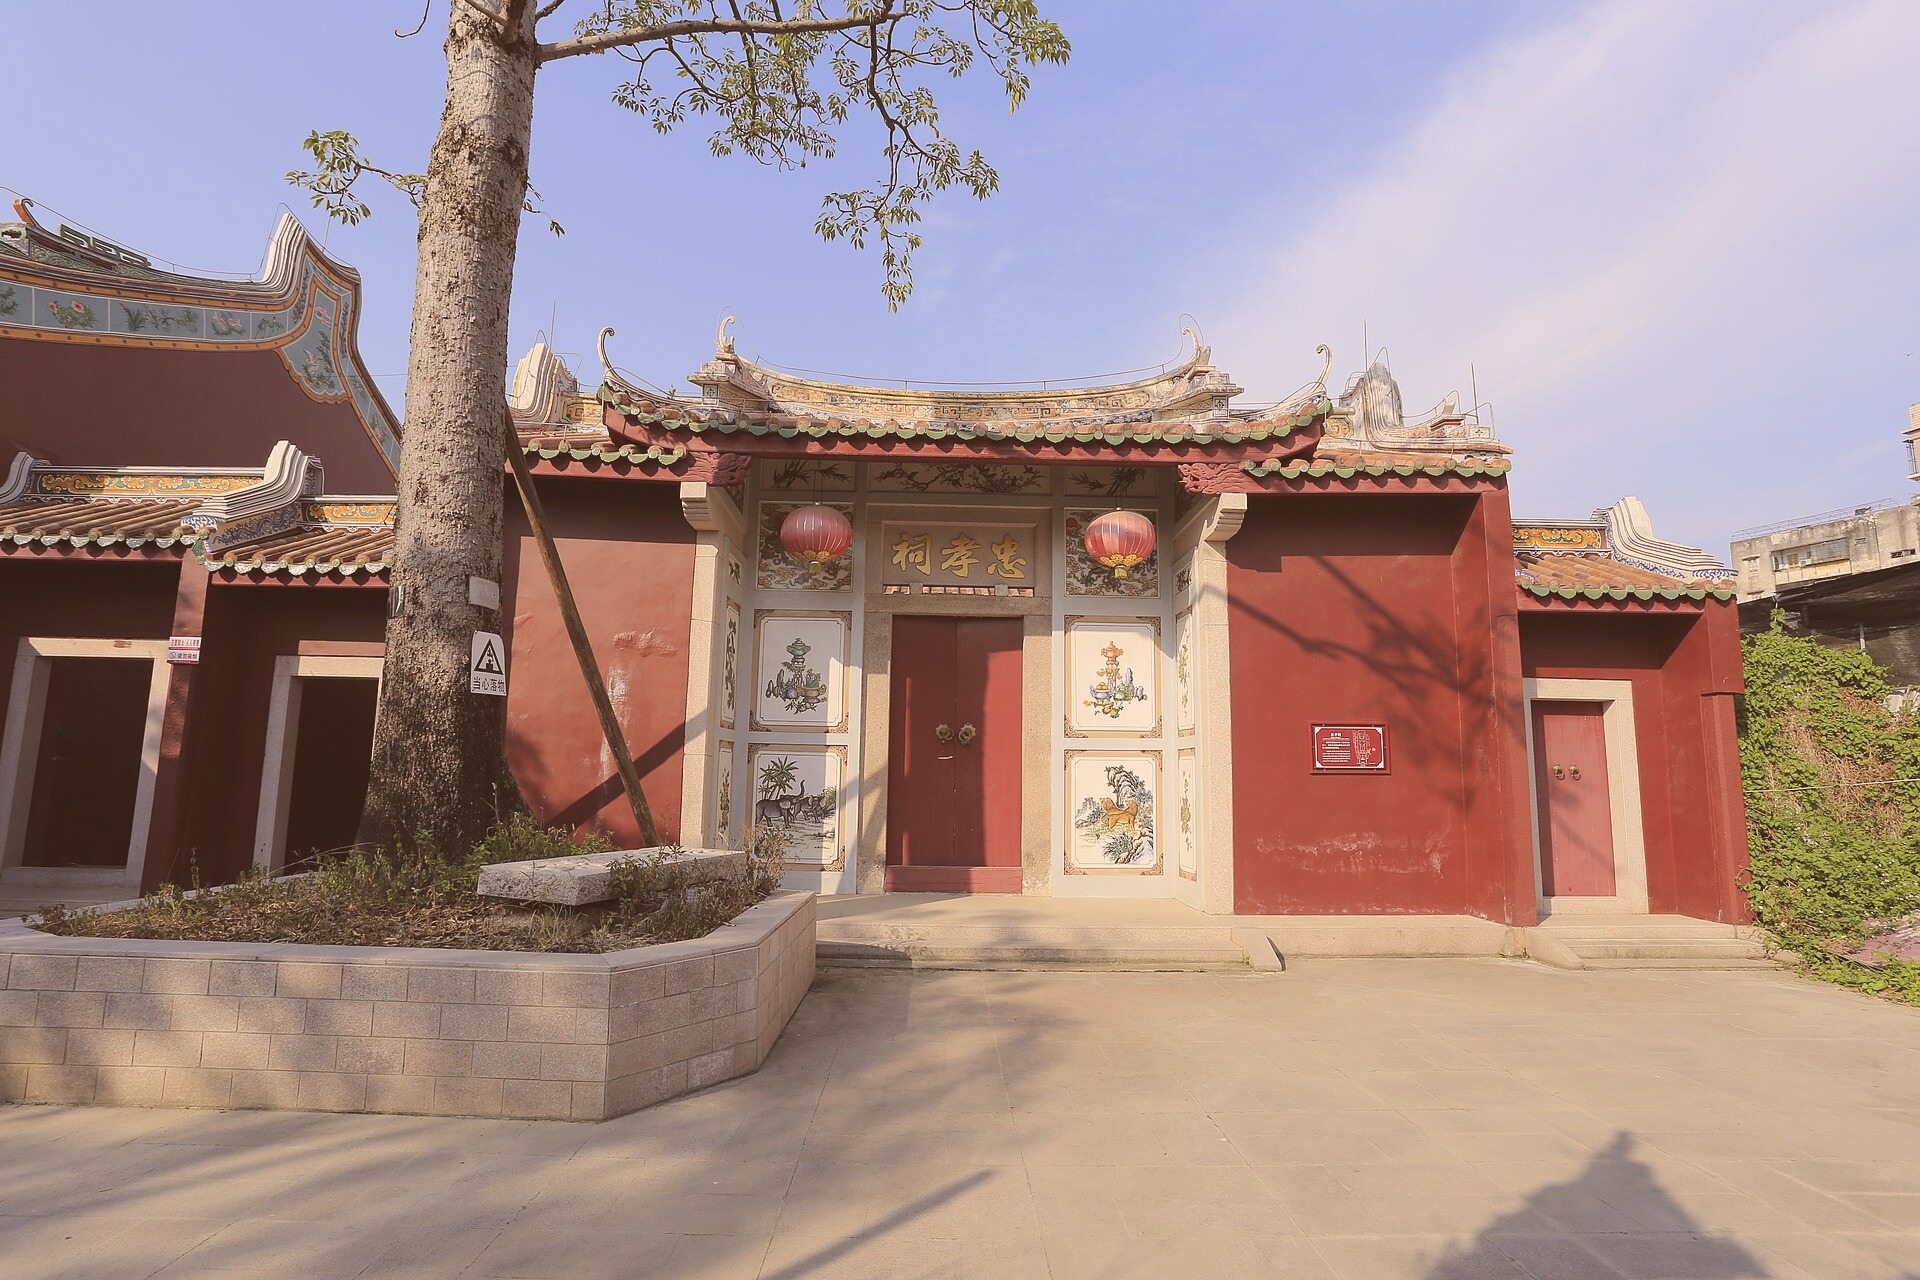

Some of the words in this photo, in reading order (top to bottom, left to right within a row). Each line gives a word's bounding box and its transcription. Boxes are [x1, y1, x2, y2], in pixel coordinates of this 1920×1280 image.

[891, 532, 1027, 579] 忠孝祠
[473, 676, 504, 692] 当心落物
